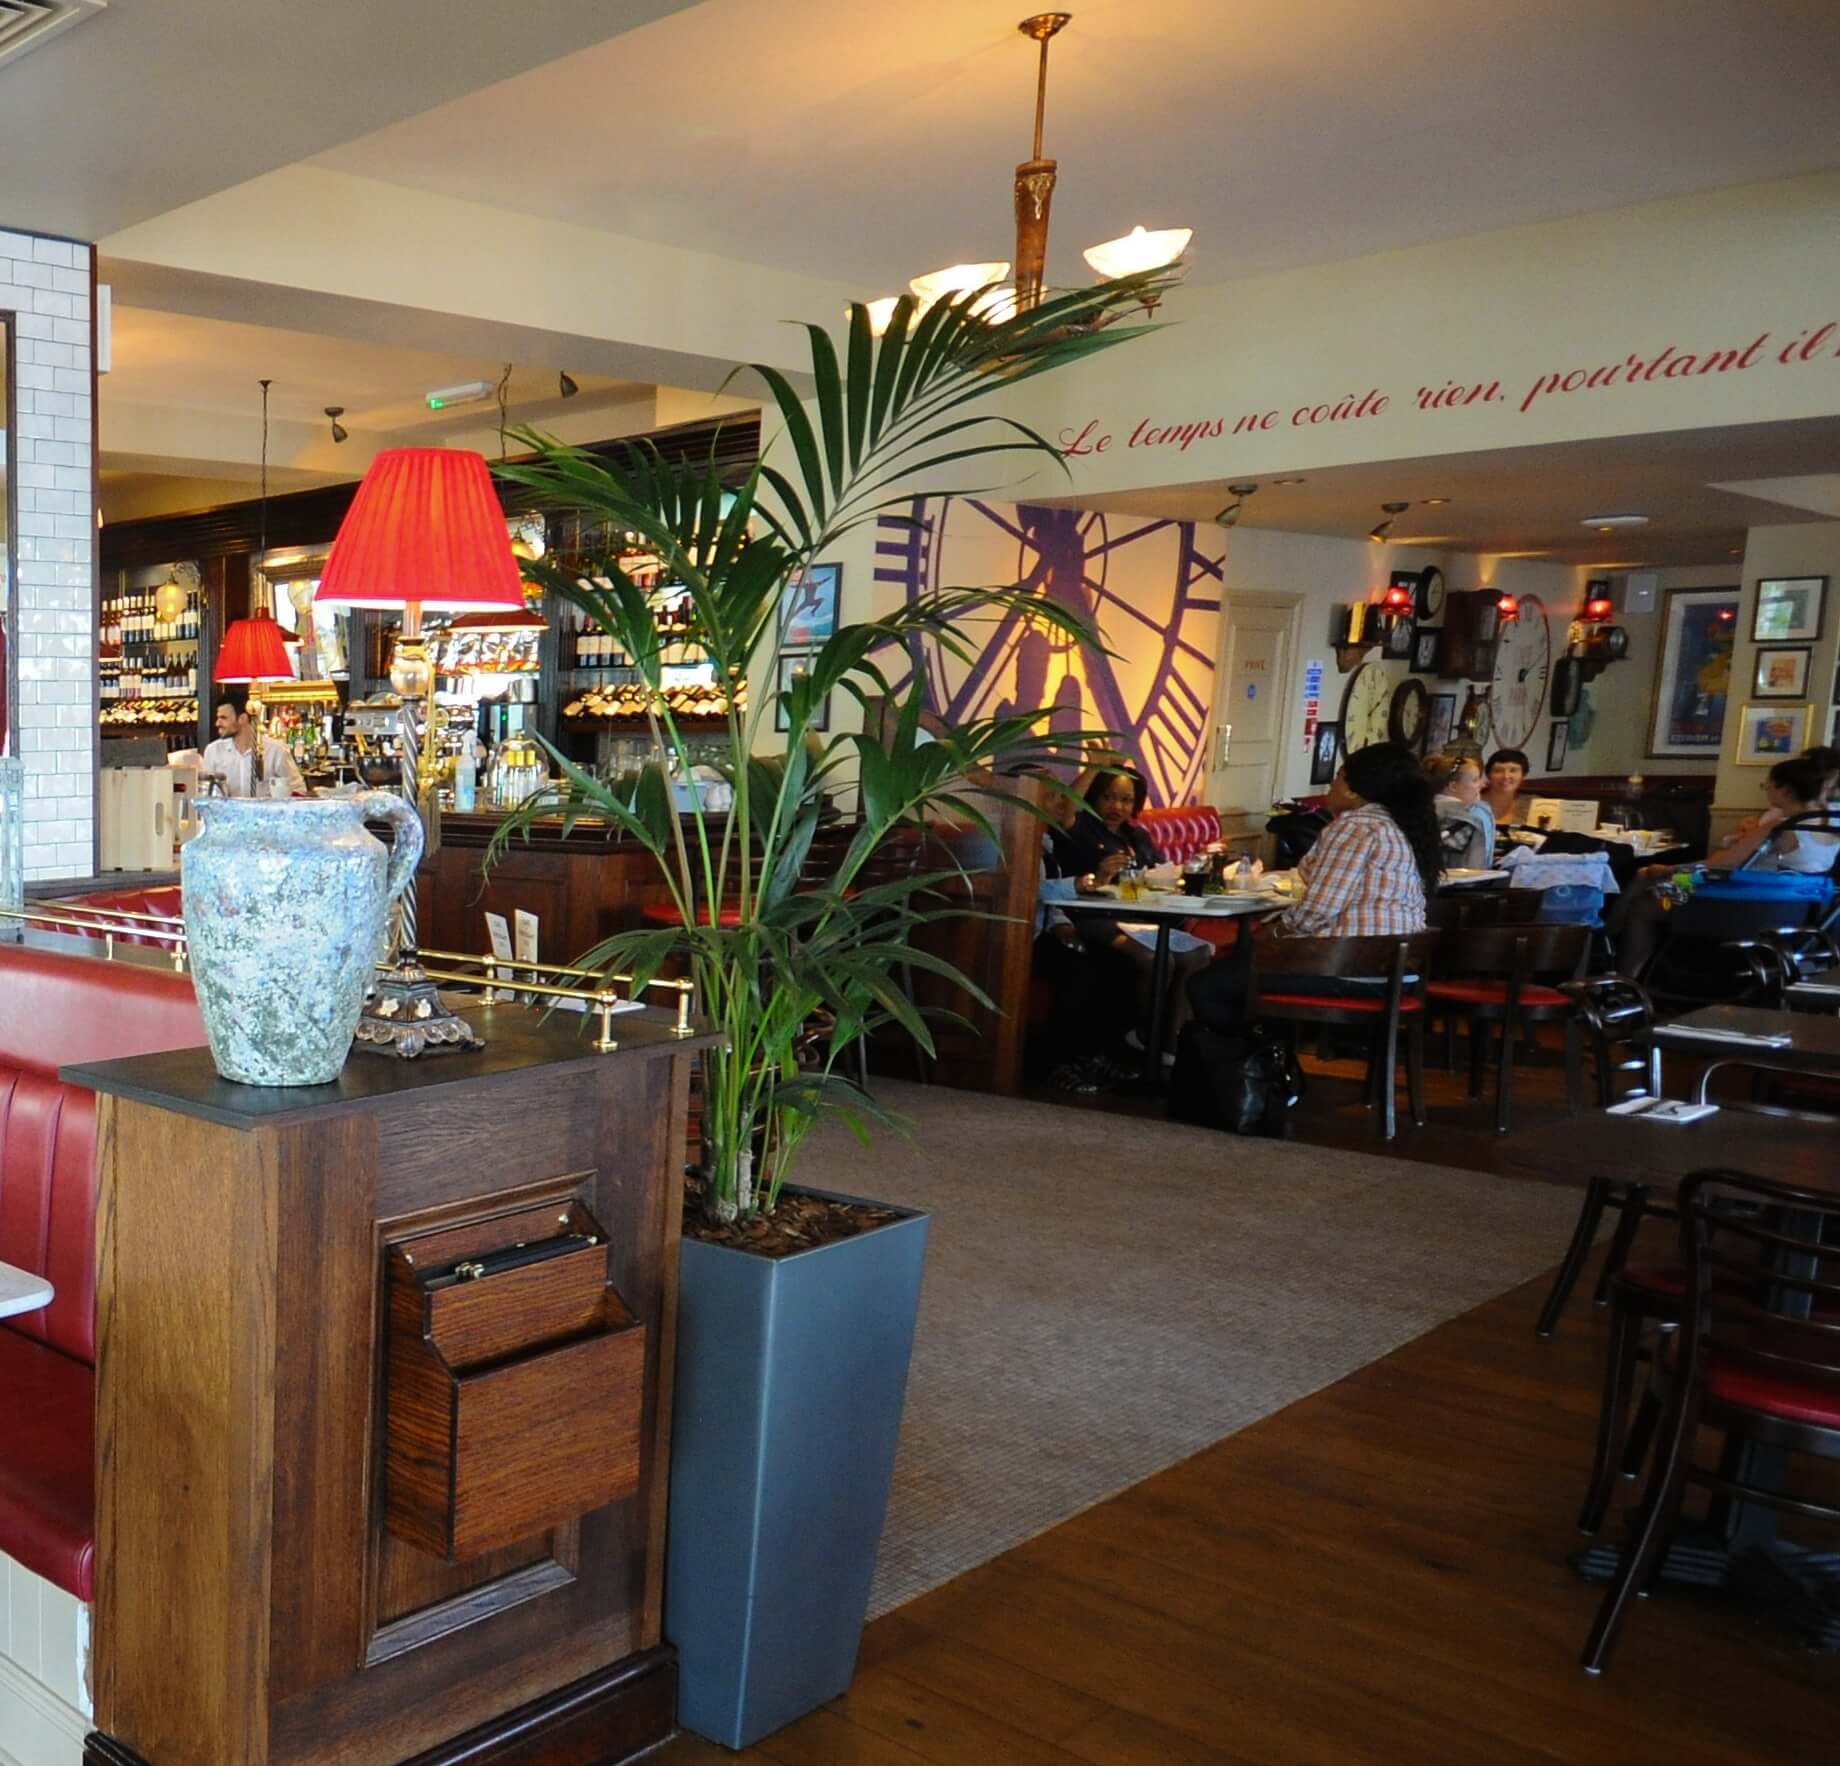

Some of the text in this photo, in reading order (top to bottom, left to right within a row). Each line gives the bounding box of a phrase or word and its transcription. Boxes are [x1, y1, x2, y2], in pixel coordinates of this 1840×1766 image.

[1060, 419, 1111, 457] Le
[1128, 418, 1224, 451] temps
[1232, 411, 1278, 434] ne
[1292, 389, 1390, 427] coûte
[1519, 332, 1770, 412] pourtant
[1778, 322, 1837, 364] il
